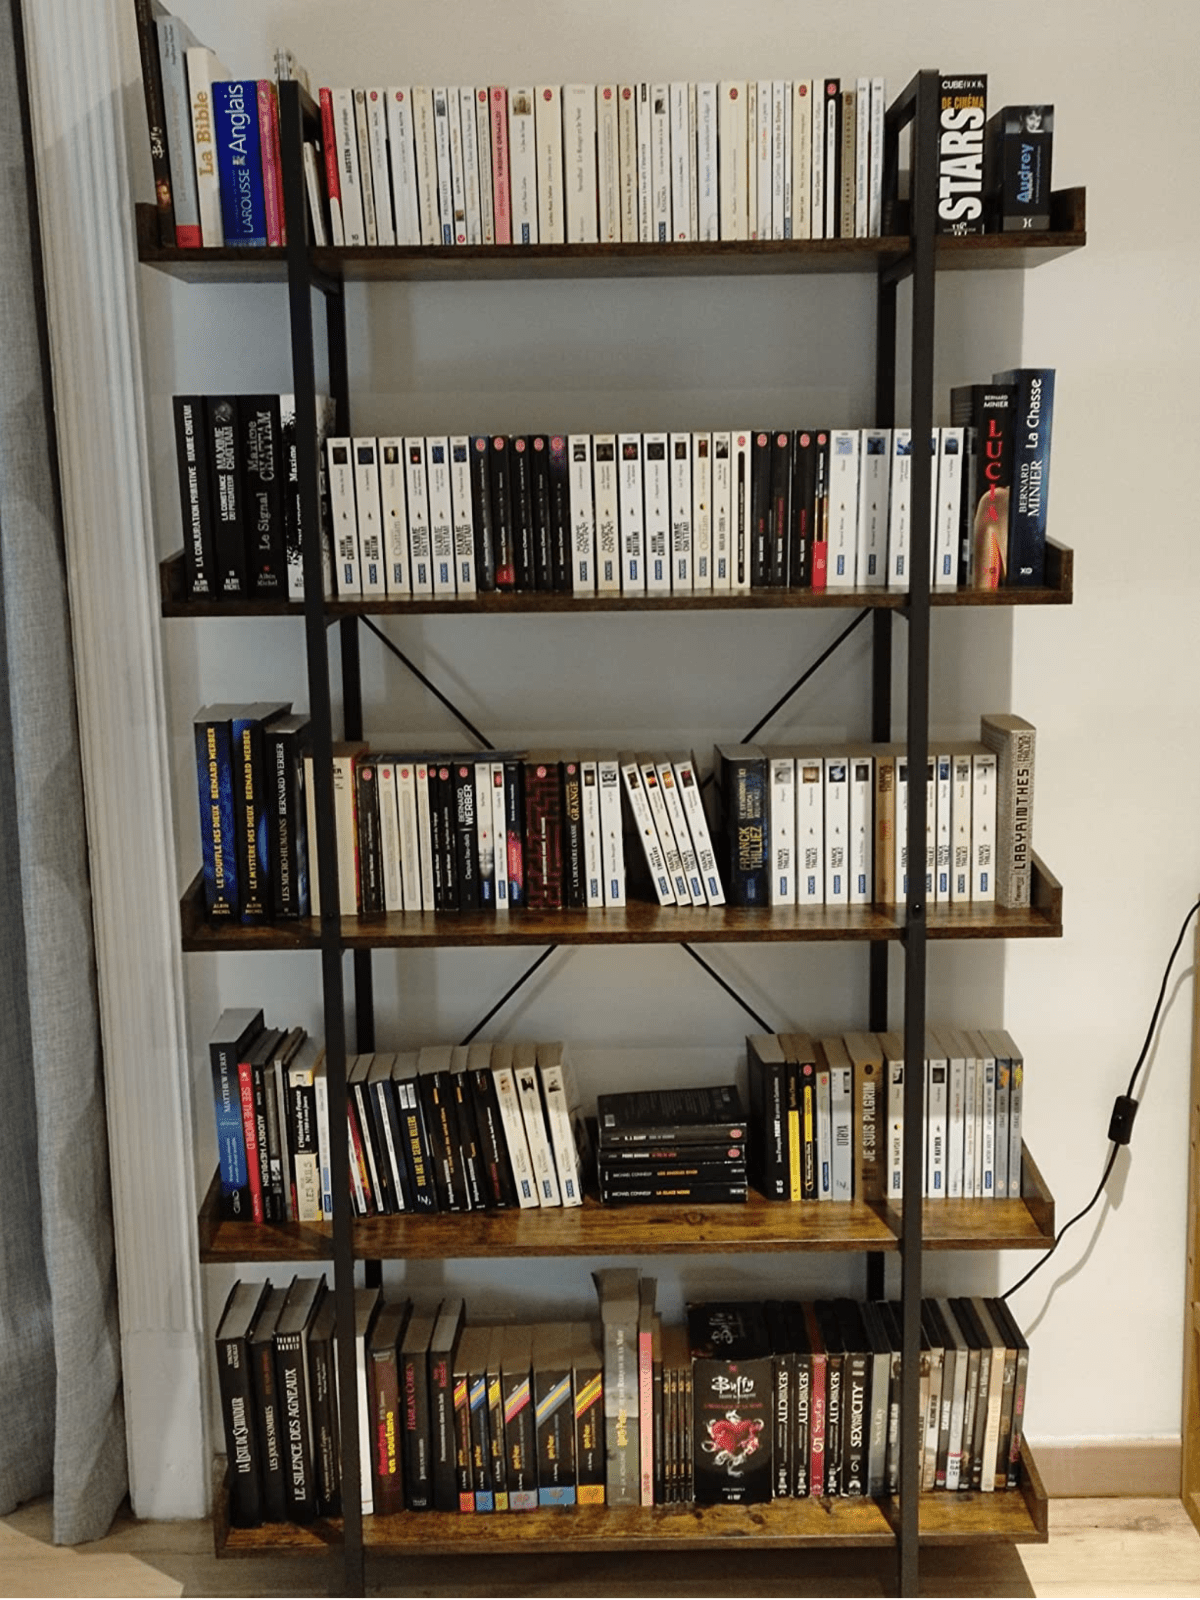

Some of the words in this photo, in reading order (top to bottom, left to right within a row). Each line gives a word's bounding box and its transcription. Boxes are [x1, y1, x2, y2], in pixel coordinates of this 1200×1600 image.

[941, 97, 952, 110] DE
[954, 94, 985, 109] CINÉMA
[194, 92, 212, 145] Bible
[224, 84, 251, 155] Anglais
[199, 150, 214, 177] La
[344, 148, 352, 174] AUSTEN
[938, 107, 985, 221] STARS
[1016, 143, 1034, 204] Audrey
[238, 169, 254, 233] LAROUSSE
[983, 400, 1009, 408] MINIER
[1026, 378, 1042, 428] Chasse
[183, 404, 194, 436] CHATTAM
[186, 435, 196, 462] MAXIME
[214, 427, 226, 470] MAXIME
[222, 426, 235, 470] CHATTAM
[247, 421, 258, 472] Maxime
[257, 411, 274, 481] CHATTAM
[1025, 432, 1039, 449] La
[289, 445, 298, 481] Maxime
[188, 466, 199, 504] PRIMITIVE
[1019, 463, 1029, 513] BERNARD
[1028, 459, 1043, 516] MINIER
[256, 492, 270, 532] Signal
[192, 504, 203, 556] CONJURATION
[259, 533, 271, 549] Le
[412, 526, 421, 557] MAXIME
[456, 525, 465, 556] MAXIME
[632, 531, 640, 556] CHATTAM
[657, 531, 665, 556] CHATTAM
[674, 522, 682, 552] MAXIME
[682, 521, 690, 552] CHATTAM
[195, 557, 204, 567] LA
[346, 535, 355, 561] CHATTAM
[371, 535, 380, 560] CHATTAM
[207, 727, 217, 760] WERBER
[243, 730, 252, 761] WERBER
[1016, 737, 1024, 762] FRANCK
[275, 742, 286, 776] WERBER
[209, 761, 219, 799] BERNARD
[245, 763, 253, 800] BERNARD
[277, 776, 287, 815] BERNARD
[464, 784, 474, 825] WERBER
[211, 804, 221, 828] DIEUX
[246, 805, 255, 828] DIEUX
[1014, 769, 1030, 870] LABYRINTHES
[213, 828, 221, 843] DES
[247, 829, 255, 843] DES
[570, 824, 578, 847] CHASSE
[739, 826, 750, 871] FRANCK
[750, 826, 763, 869] THILLIEZ
[214, 844, 223, 878] SOUFFLE
[247, 844, 256, 879] MYSTÈRE
[279, 818, 290, 885] MICRO-HUMAINS
[571, 848, 579, 879] DERNIÈRE
[216, 879, 224, 889] LE
[249, 879, 257, 889] LE
[464, 860, 472, 880] Depuis
[572, 878, 579, 888] LA
[281, 885, 290, 902] LES
[219, 1051, 228, 1074] PERRY
[221, 1075, 231, 1113] MATTHEW
[241, 1086, 251, 1102] SEE
[294, 1090, 302, 1111] France
[863, 1082, 875, 1122] PILGRIM
[296, 1111, 303, 1119] de
[257, 1114, 267, 1147] AUDREY
[296, 1119, 305, 1148] L'Histoire
[863, 1124, 875, 1147] SUIS
[260, 1148, 270, 1187] HEPBURN
[863, 1149, 876, 1161] JE
[285, 1368, 300, 1418] AGNEAUX
[405, 1363, 415, 1394] COBEN
[711, 1375, 754, 1405] Buffy
[778, 1371, 788, 1389] SEX
[799, 1371, 808, 1389] SEX
[830, 1371, 840, 1389] SEX
[406, 1395, 416, 1430] HARLAN
[778, 1399, 788, 1423] CITY
[798, 1399, 808, 1423] CITY
[830, 1399, 840, 1423] CITY
[852, 1382, 863, 1413] CITY
[231, 1397, 249, 1436] SCHINDLER
[265, 1405, 275, 1437] SOMBRES
[288, 1420, 301, 1441] DES
[235, 1436, 247, 1445] DE
[267, 1437, 279, 1458] JOURS
[385, 1411, 395, 1457] soutane
[851, 1425, 862, 1447] SEX
[235, 1445, 251, 1463] LISTE
[238, 1463, 250, 1473] LA
[269, 1457, 278, 1471] LES
[291, 1443, 305, 1486] SILENCE
[387, 1458, 396, 1474] en
[294, 1487, 306, 1501] LE
